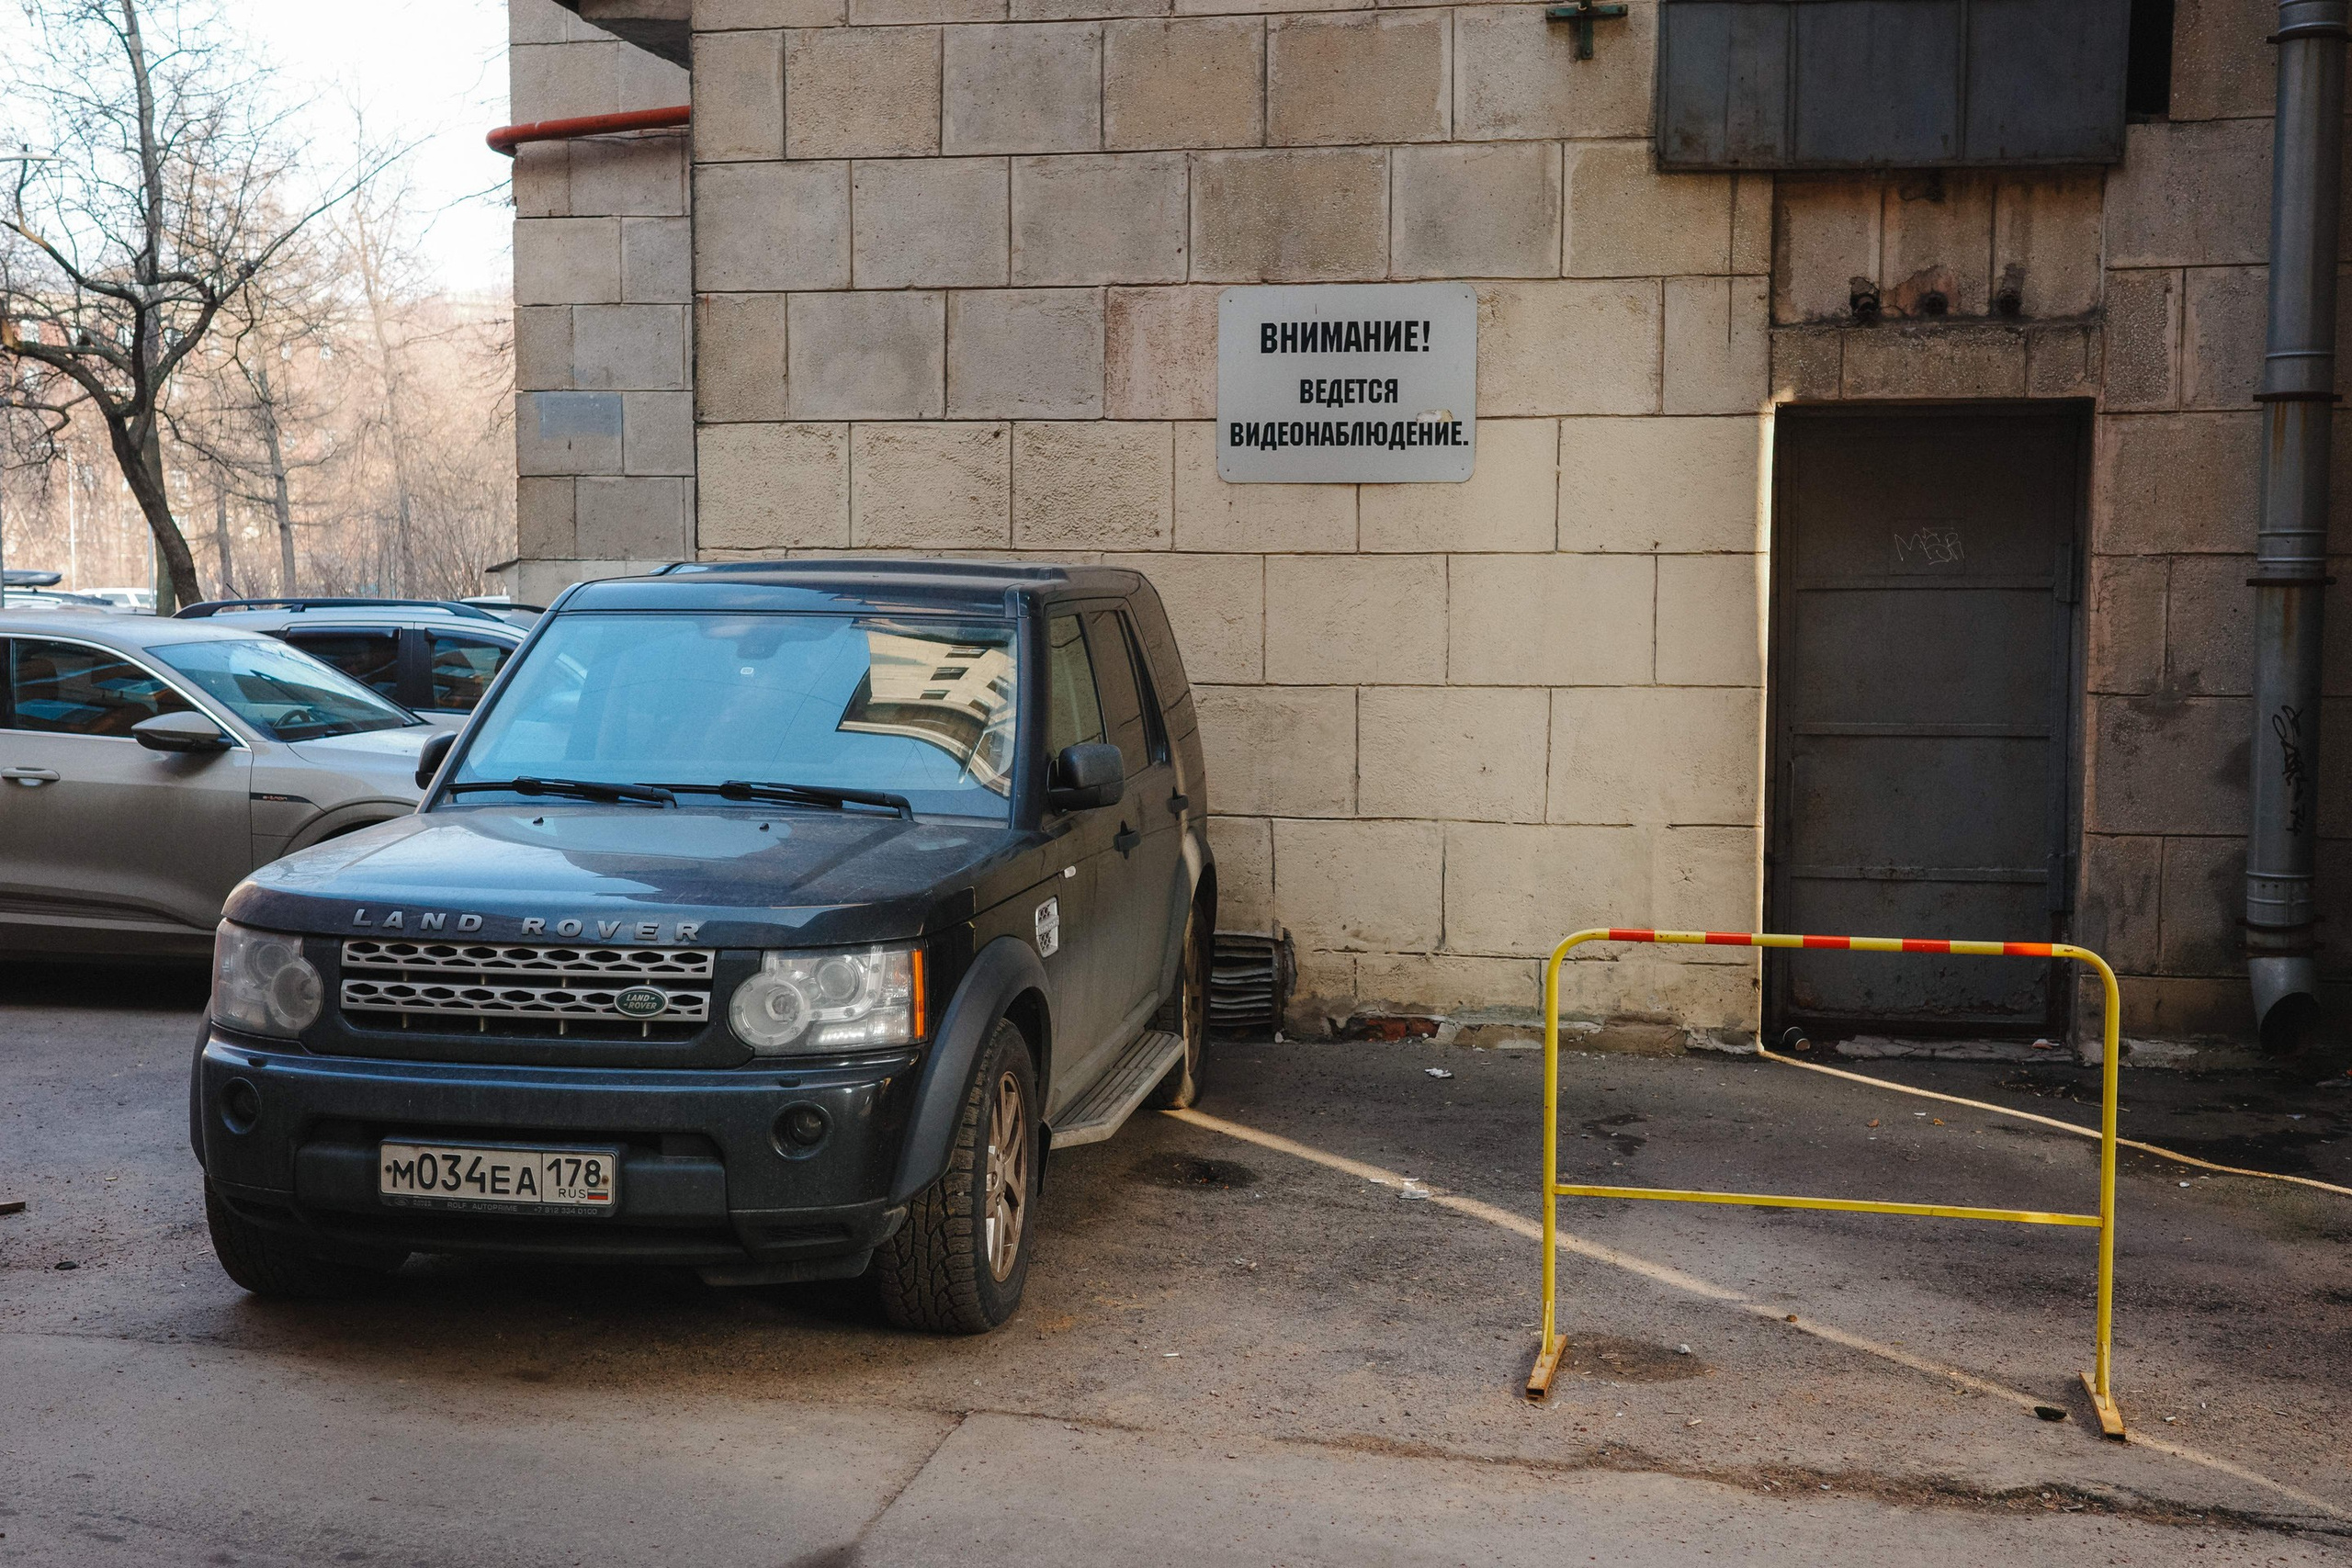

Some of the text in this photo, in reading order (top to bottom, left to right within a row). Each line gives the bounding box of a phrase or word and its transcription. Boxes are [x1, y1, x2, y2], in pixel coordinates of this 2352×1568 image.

[1261, 321, 1430, 354] ВНИМАНИЕ!
[1299, 378, 1398, 408] ВЕДЕТСЯ
[1230, 421, 1469, 451] ВИДЕОНАБЛЮДЕНИЕ.
[352, 908, 700, 942] LAND ROVER
[628, 1001, 658, 1010] ROVER
[547, 1157, 602, 1188] 178
[471, 1203, 518, 1212] AUTOPRIME
[558, 1188, 586, 1199] RUS
